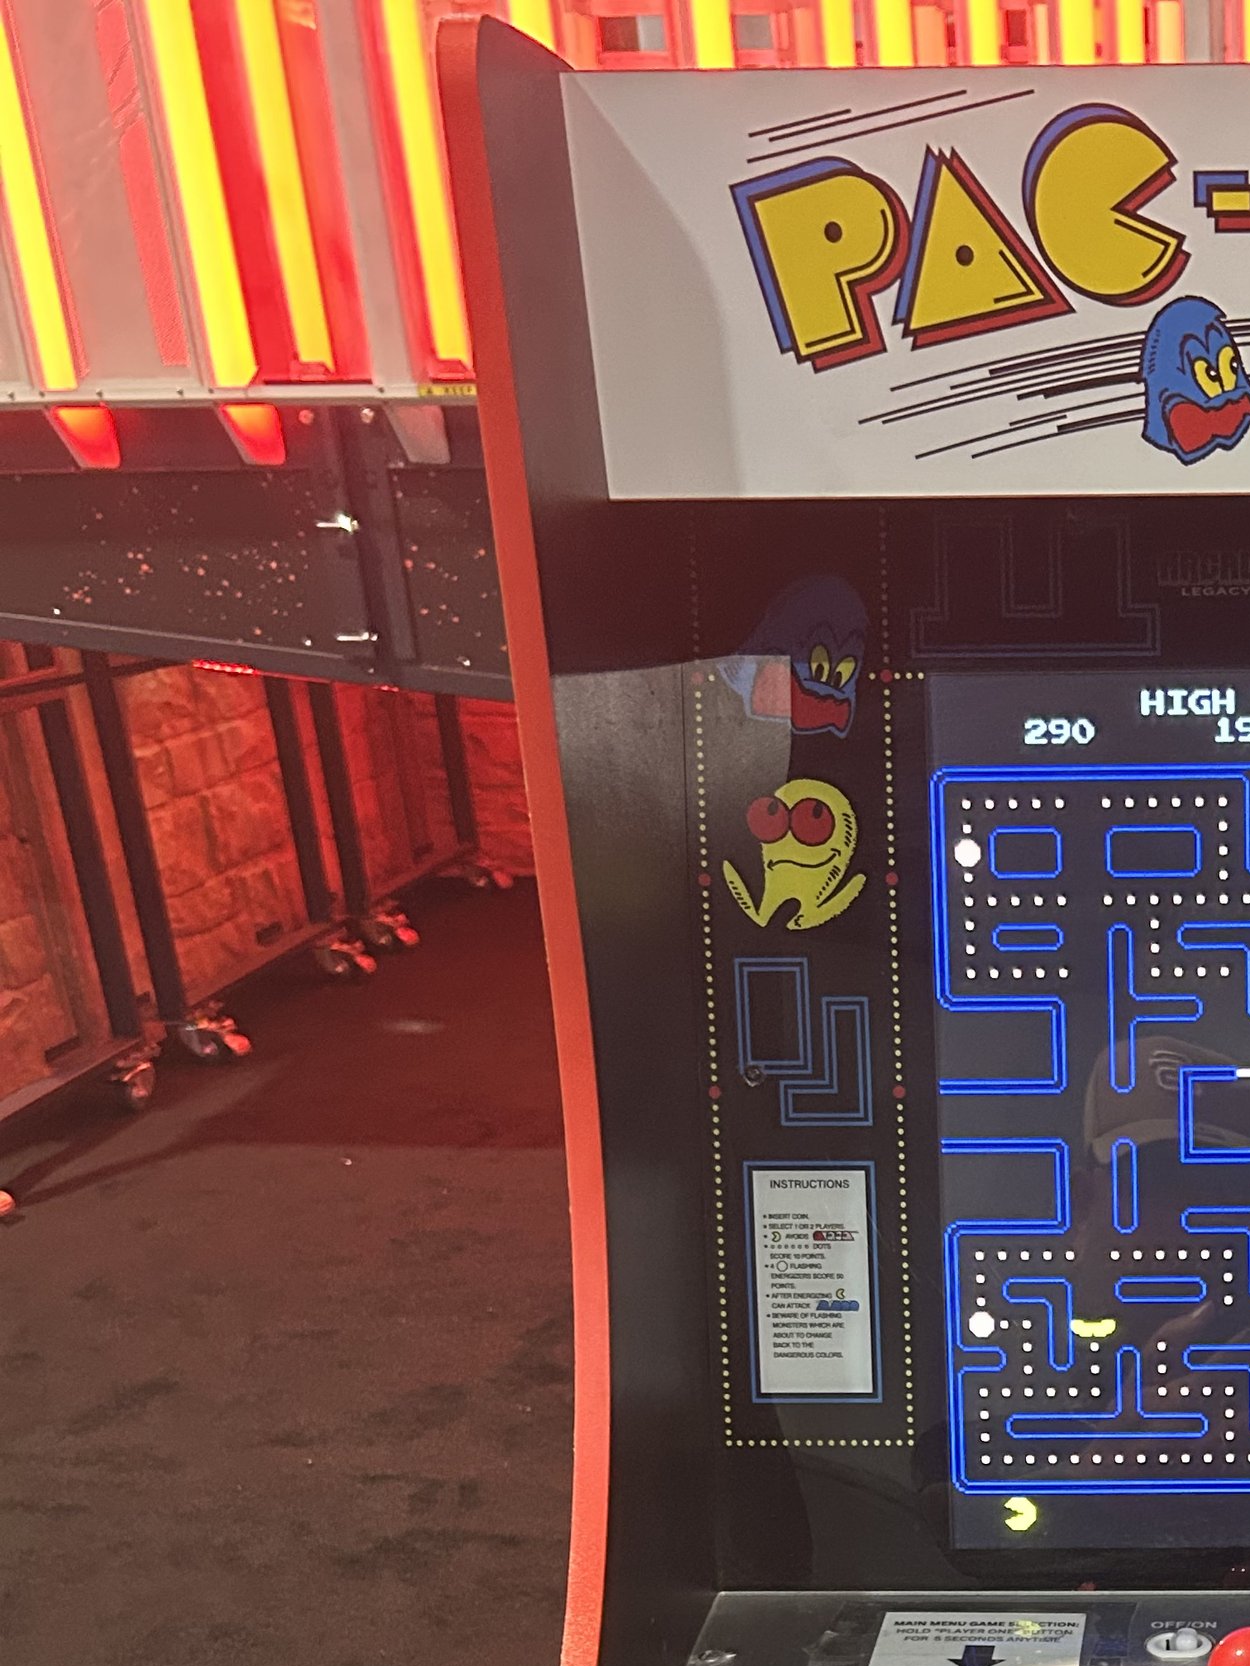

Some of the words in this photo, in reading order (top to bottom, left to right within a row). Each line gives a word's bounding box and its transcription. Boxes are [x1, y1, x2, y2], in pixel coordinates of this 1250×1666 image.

[1181, 586, 1250, 597] LEGACY
[1139, 687, 1236, 716] HIGH
[1023, 717, 1096, 745] 290
[769, 1179, 850, 1189] INSTRUCTIONS
[1150, 1620, 1218, 1629] OFF/ON
